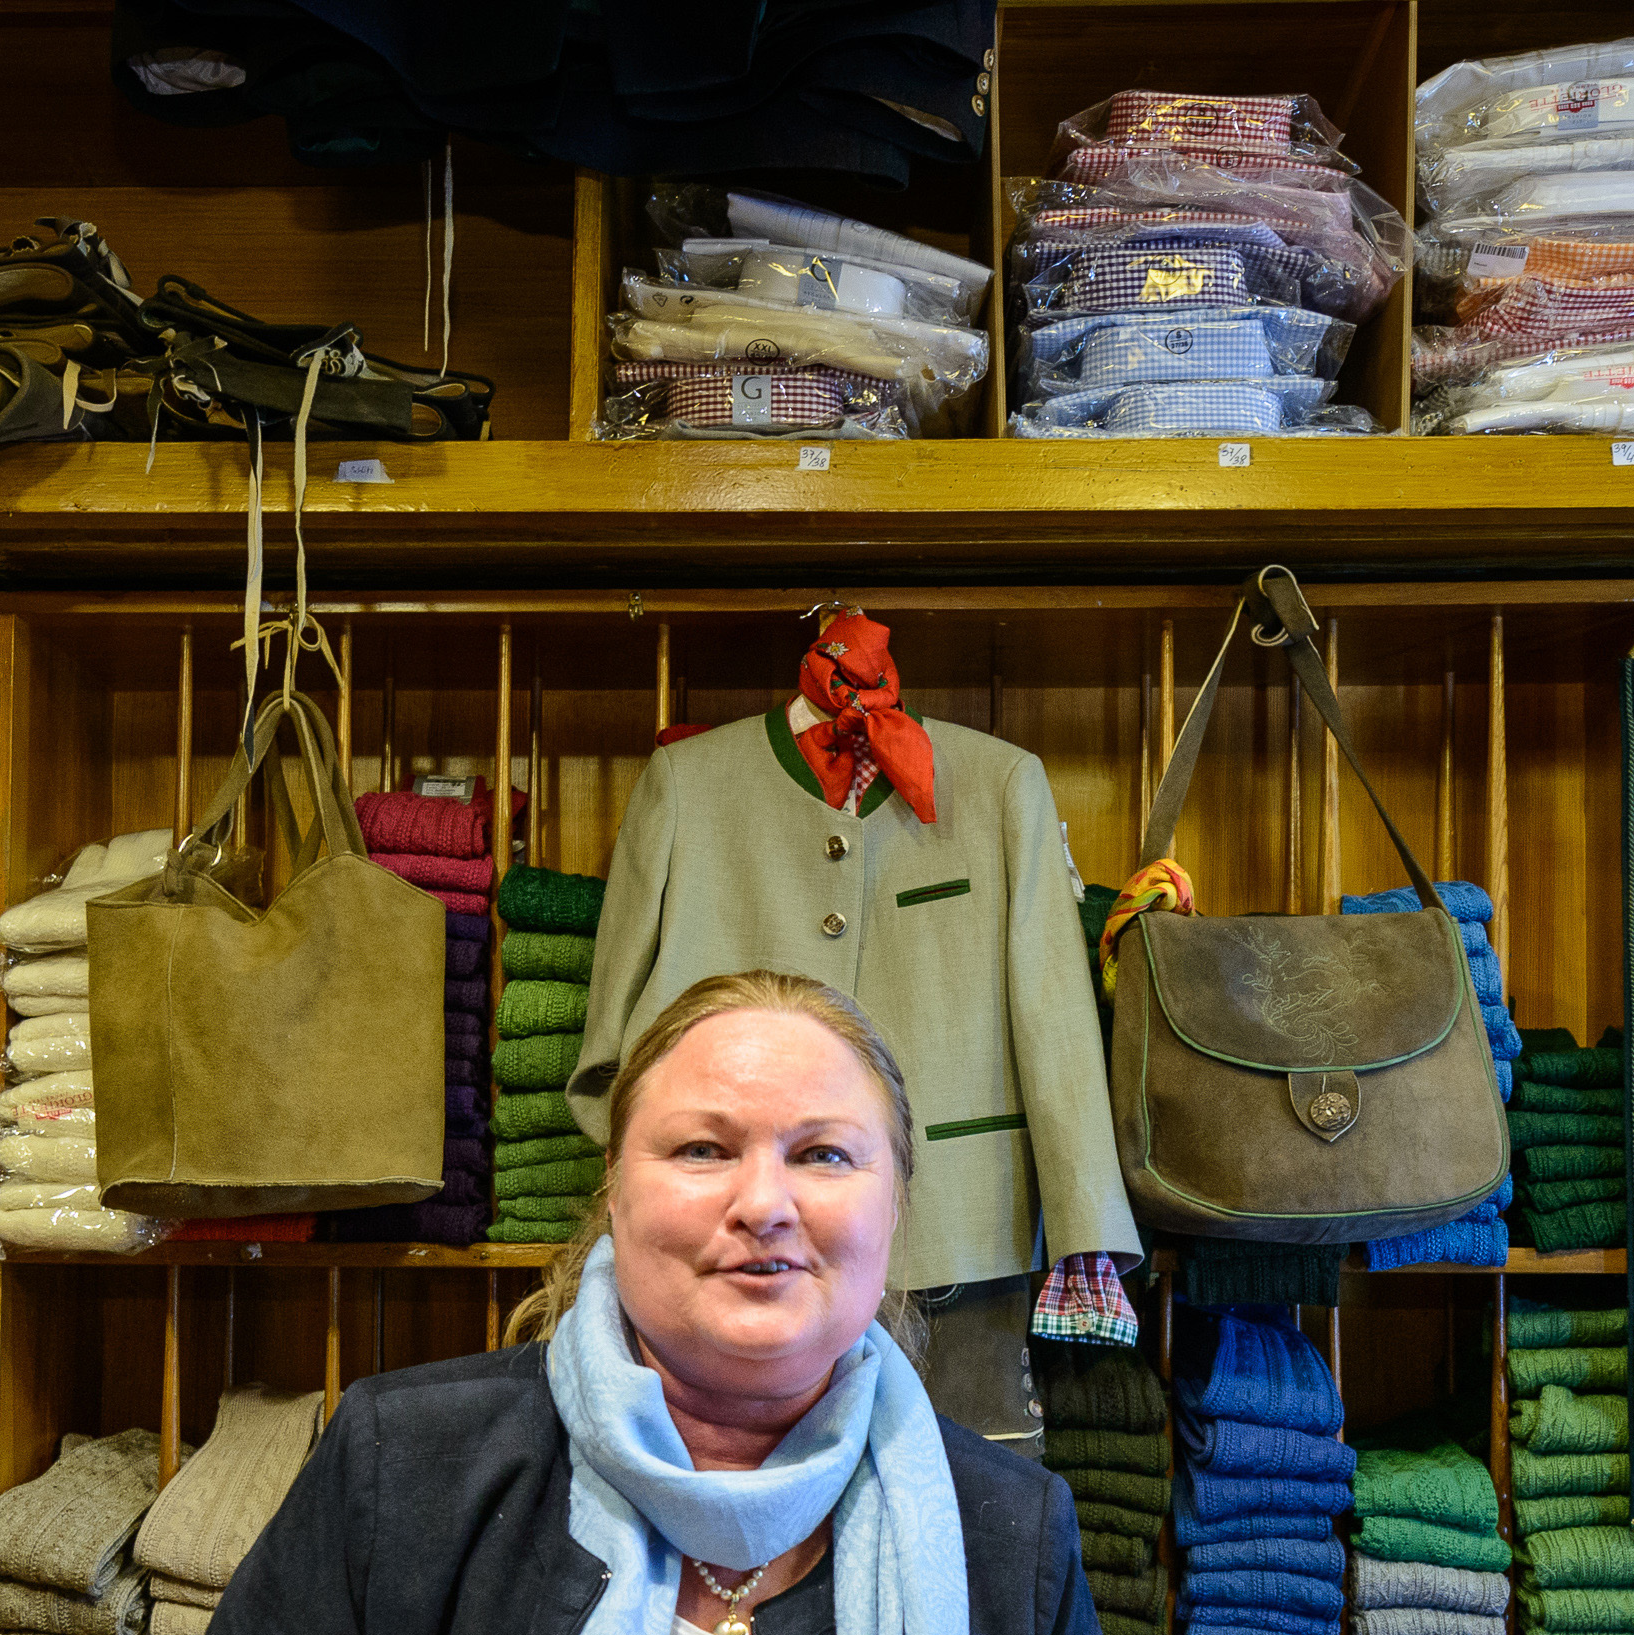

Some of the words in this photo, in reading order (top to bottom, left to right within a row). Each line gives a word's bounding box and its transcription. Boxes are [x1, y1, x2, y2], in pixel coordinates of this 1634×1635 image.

[1528, 84, 1623, 109] GLORIETTE
[741, 376, 763, 400] G
[802, 448, 828, 469] 37/38
